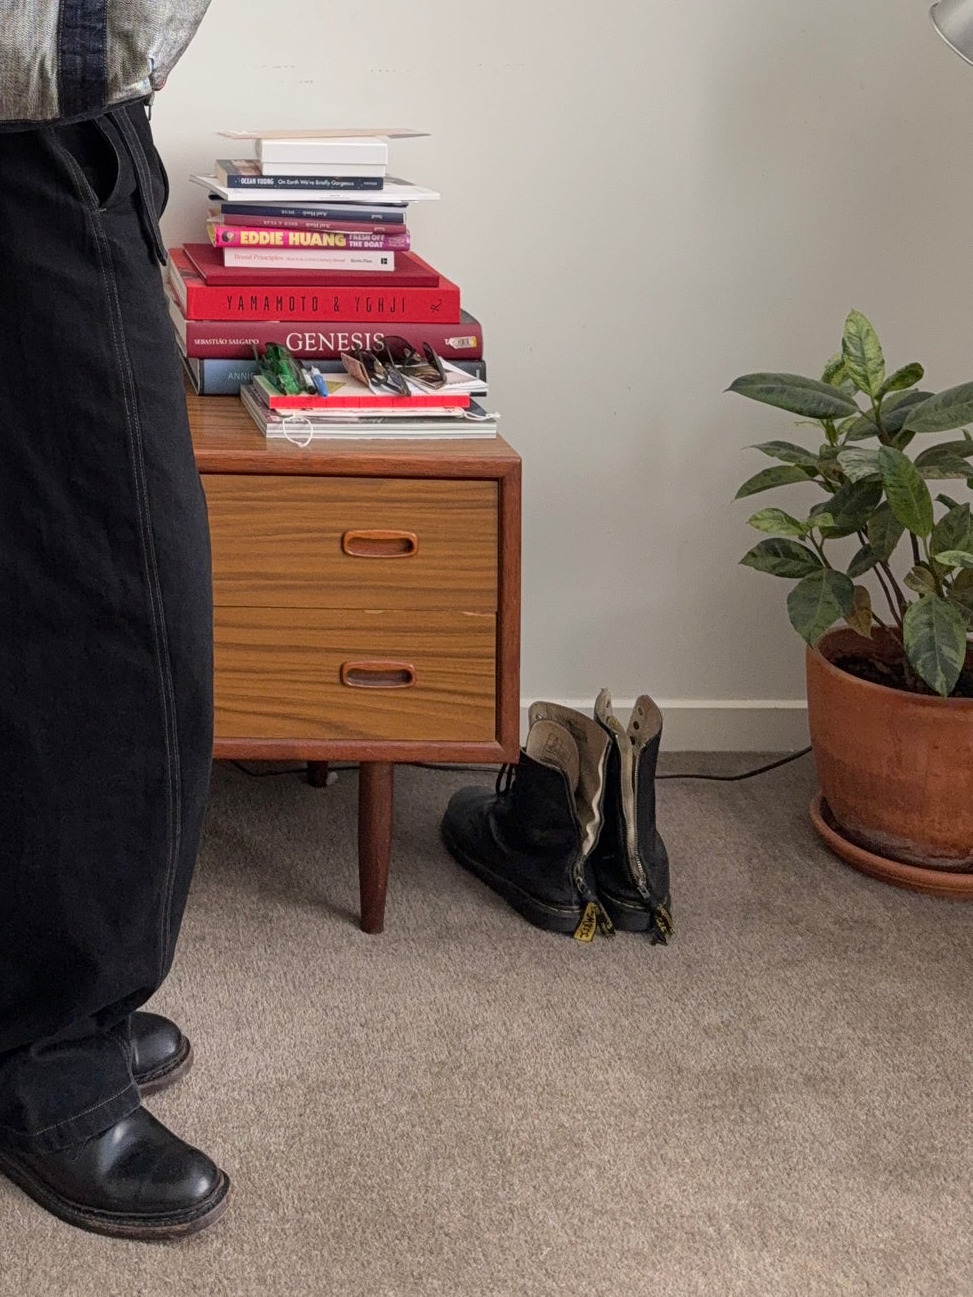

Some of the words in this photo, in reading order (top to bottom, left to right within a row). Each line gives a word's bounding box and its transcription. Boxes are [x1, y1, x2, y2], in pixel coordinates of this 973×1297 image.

[240, 231, 284, 245] EDDIE
[288, 232, 346, 247] HUANG
[227, 296, 318, 311] YAMAMOTO
[333, 296, 340, 312] &
[286, 333, 385, 352] GENESIS
